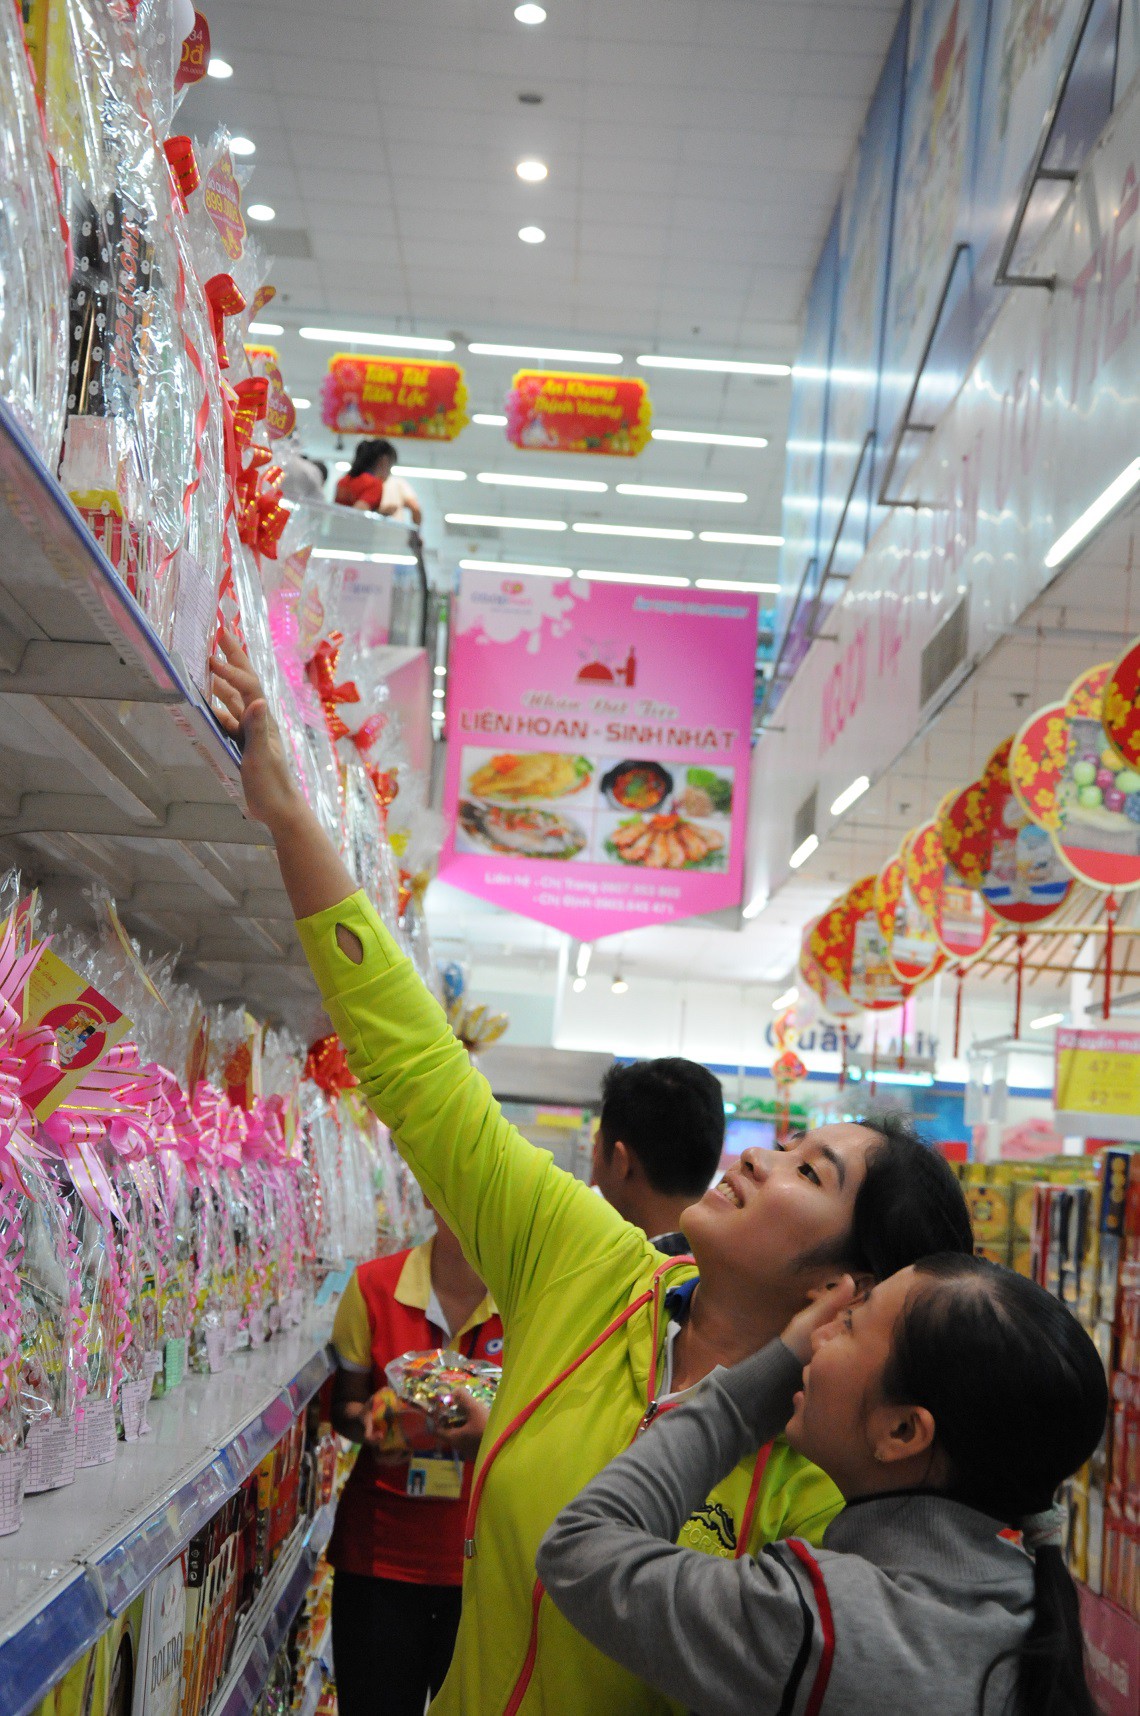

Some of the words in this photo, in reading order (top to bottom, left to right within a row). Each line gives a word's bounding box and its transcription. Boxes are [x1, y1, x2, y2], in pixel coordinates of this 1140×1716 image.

[516, 715, 589, 738] HOAN
[605, 722, 662, 746] SINH
[150, 1632, 184, 1694] BOLERO
